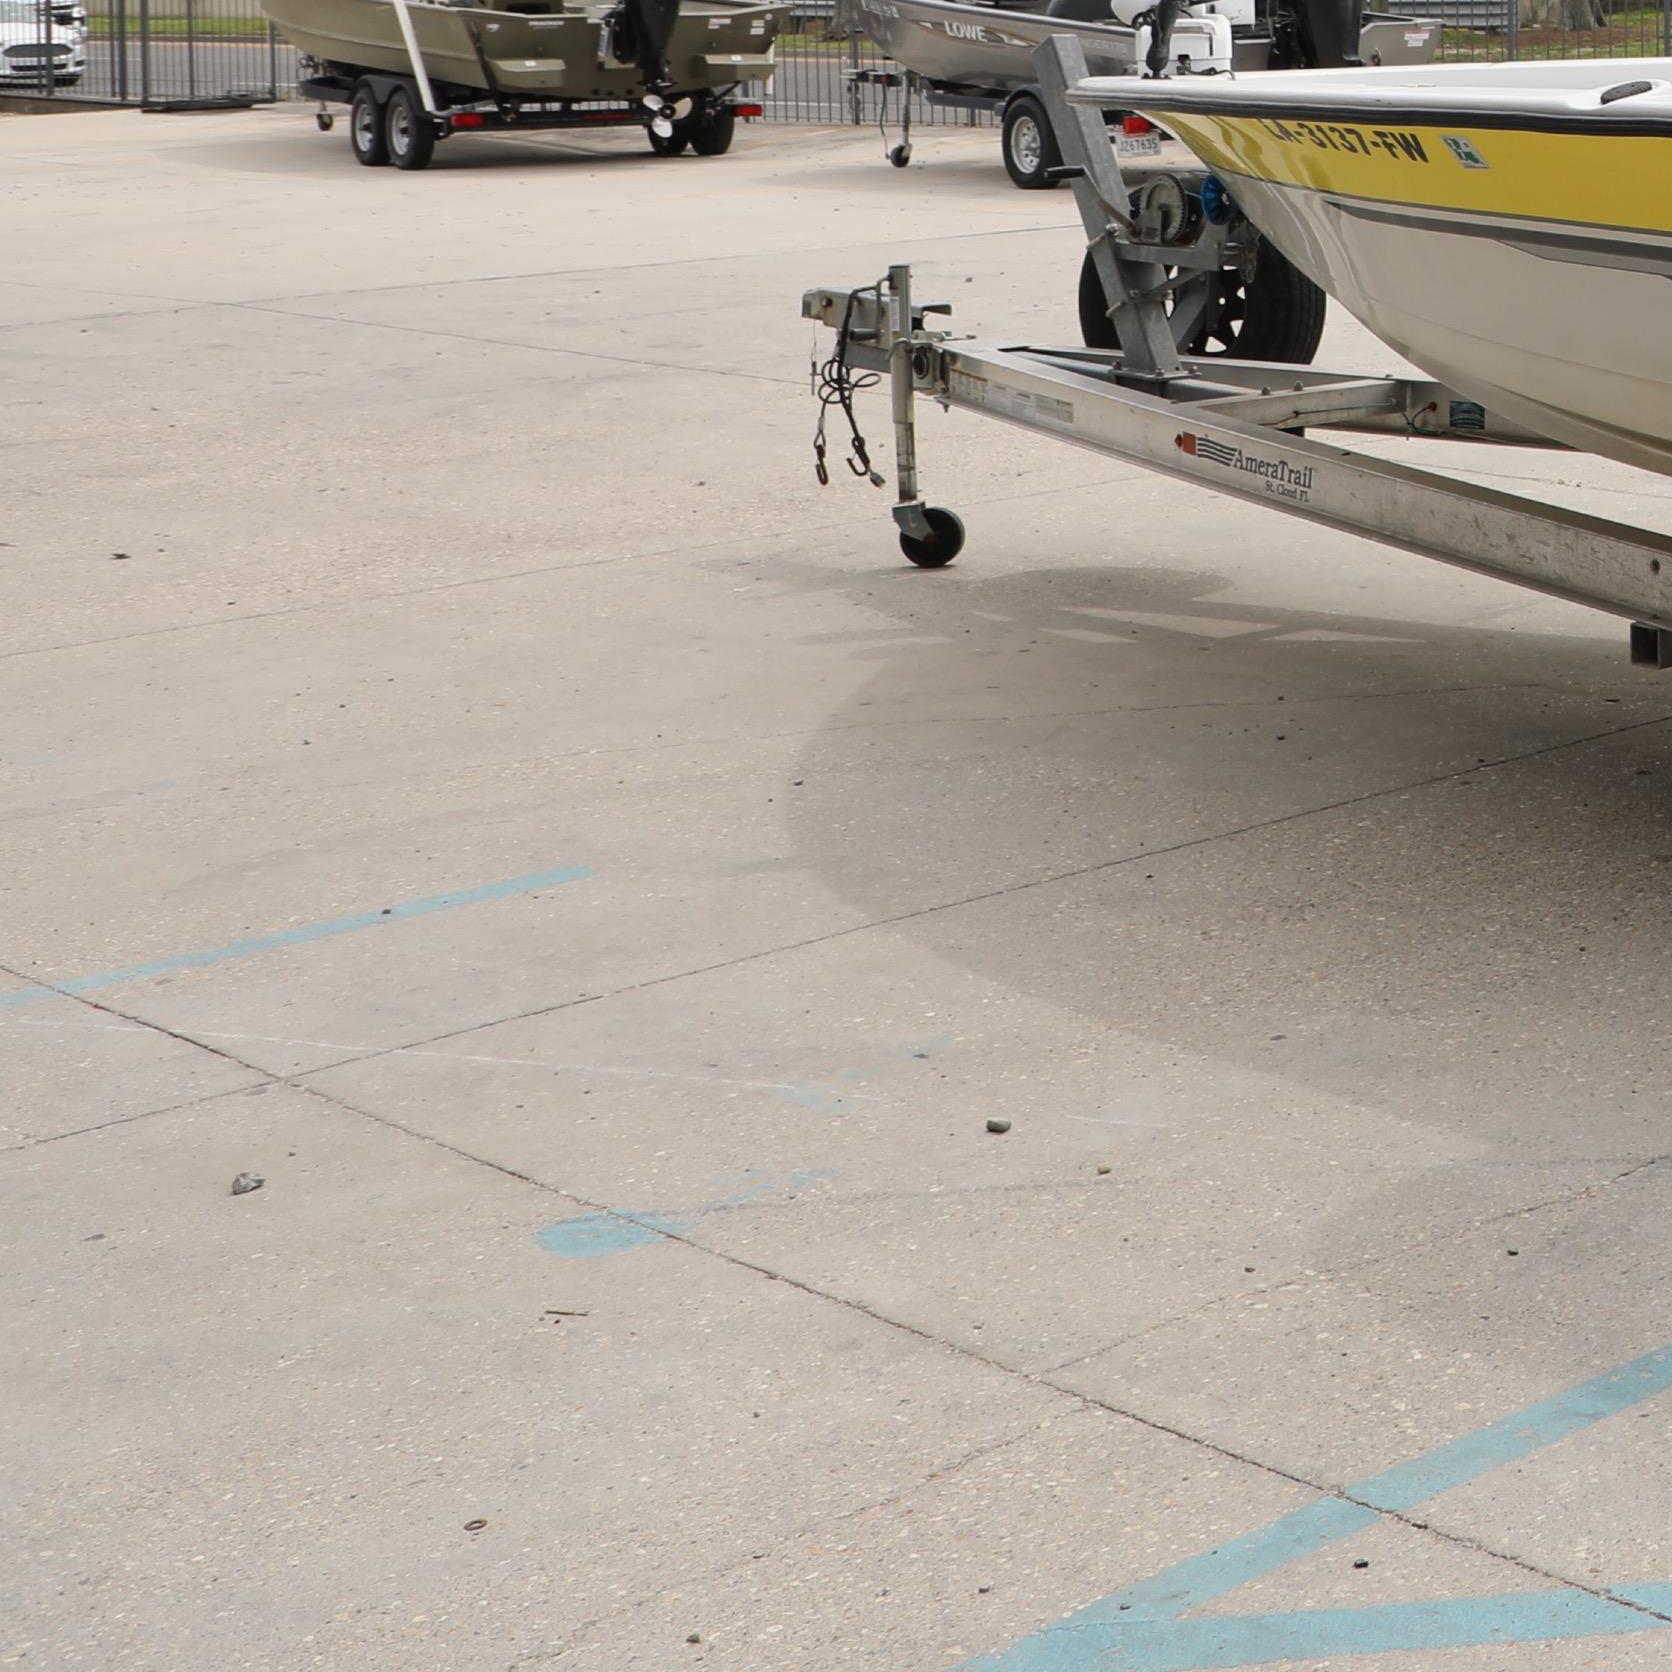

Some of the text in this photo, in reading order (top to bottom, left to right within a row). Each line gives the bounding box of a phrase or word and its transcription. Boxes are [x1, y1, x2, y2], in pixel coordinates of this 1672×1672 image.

[943, 19, 990, 43] LOWE
[1233, 449, 1313, 490] AmeraTrail
[1276, 484, 1298, 501] Cloud
[1299, 490, 1311, 503] FL
